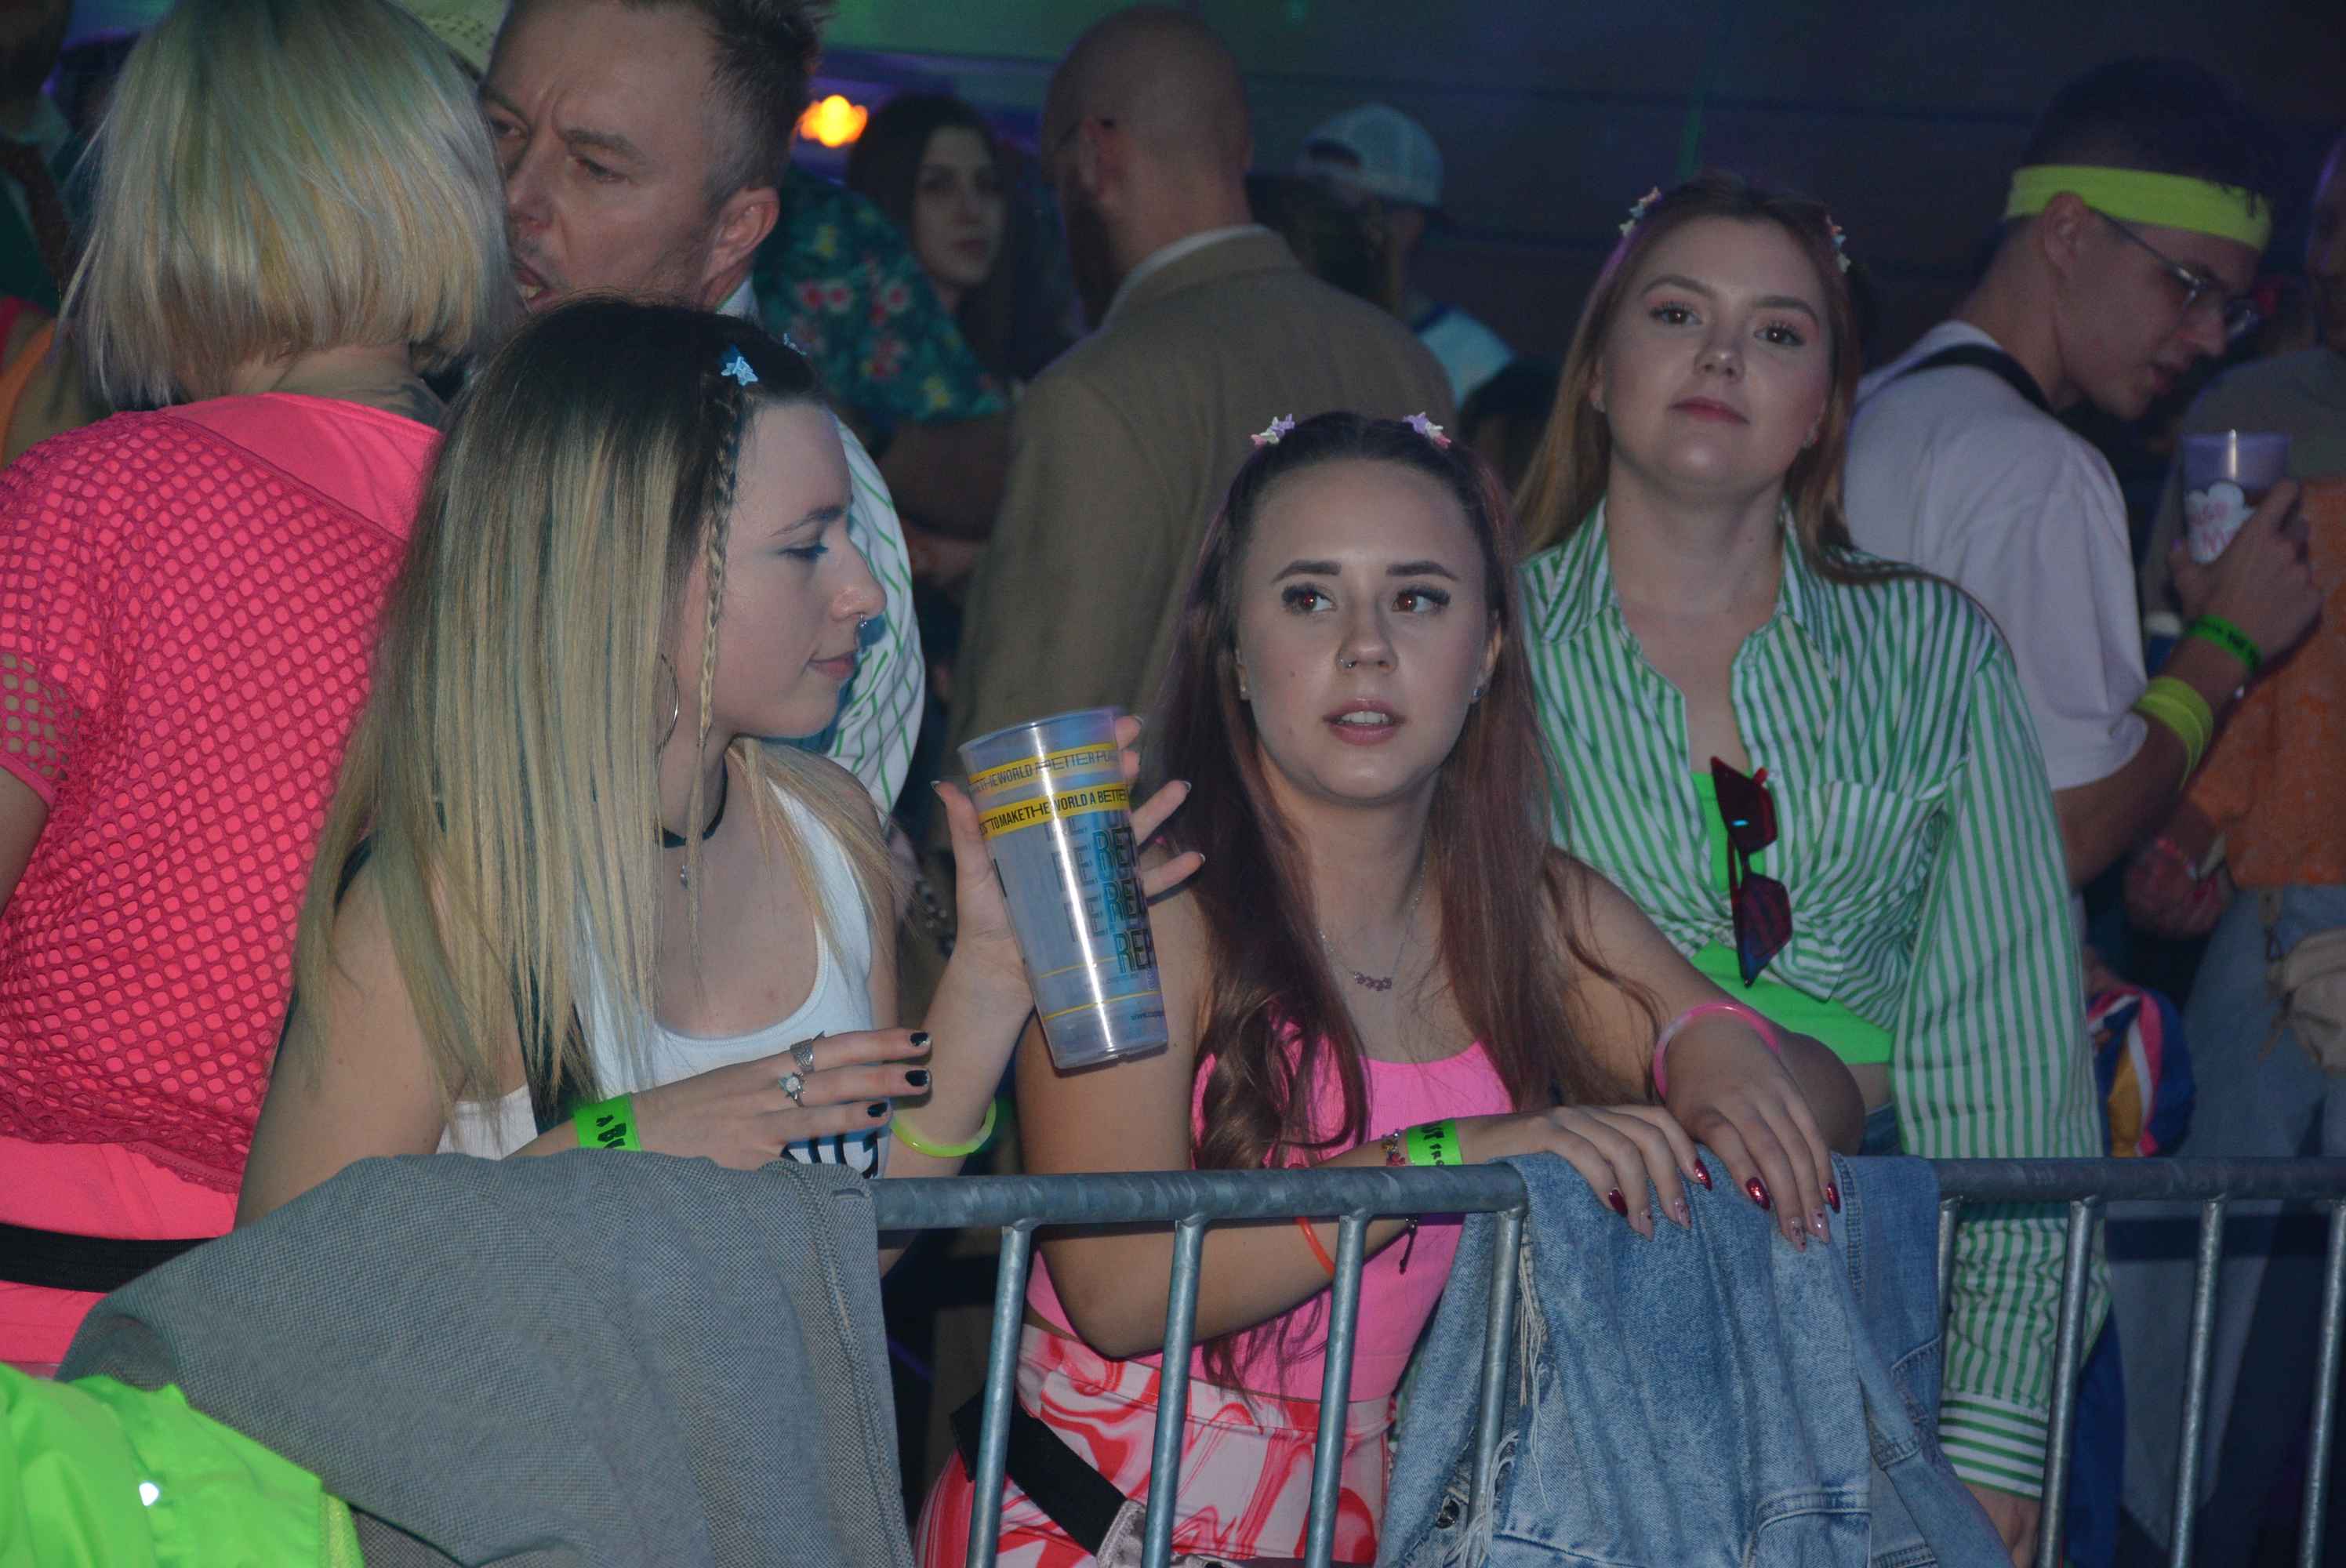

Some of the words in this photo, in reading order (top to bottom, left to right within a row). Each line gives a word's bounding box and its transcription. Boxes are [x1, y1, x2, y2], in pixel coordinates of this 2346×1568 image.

[999, 808, 1025, 827] MAKE
[1022, 800, 1049, 820] THE
[1089, 792, 1096, 805] A
[1097, 788, 1130, 804] BETTE
